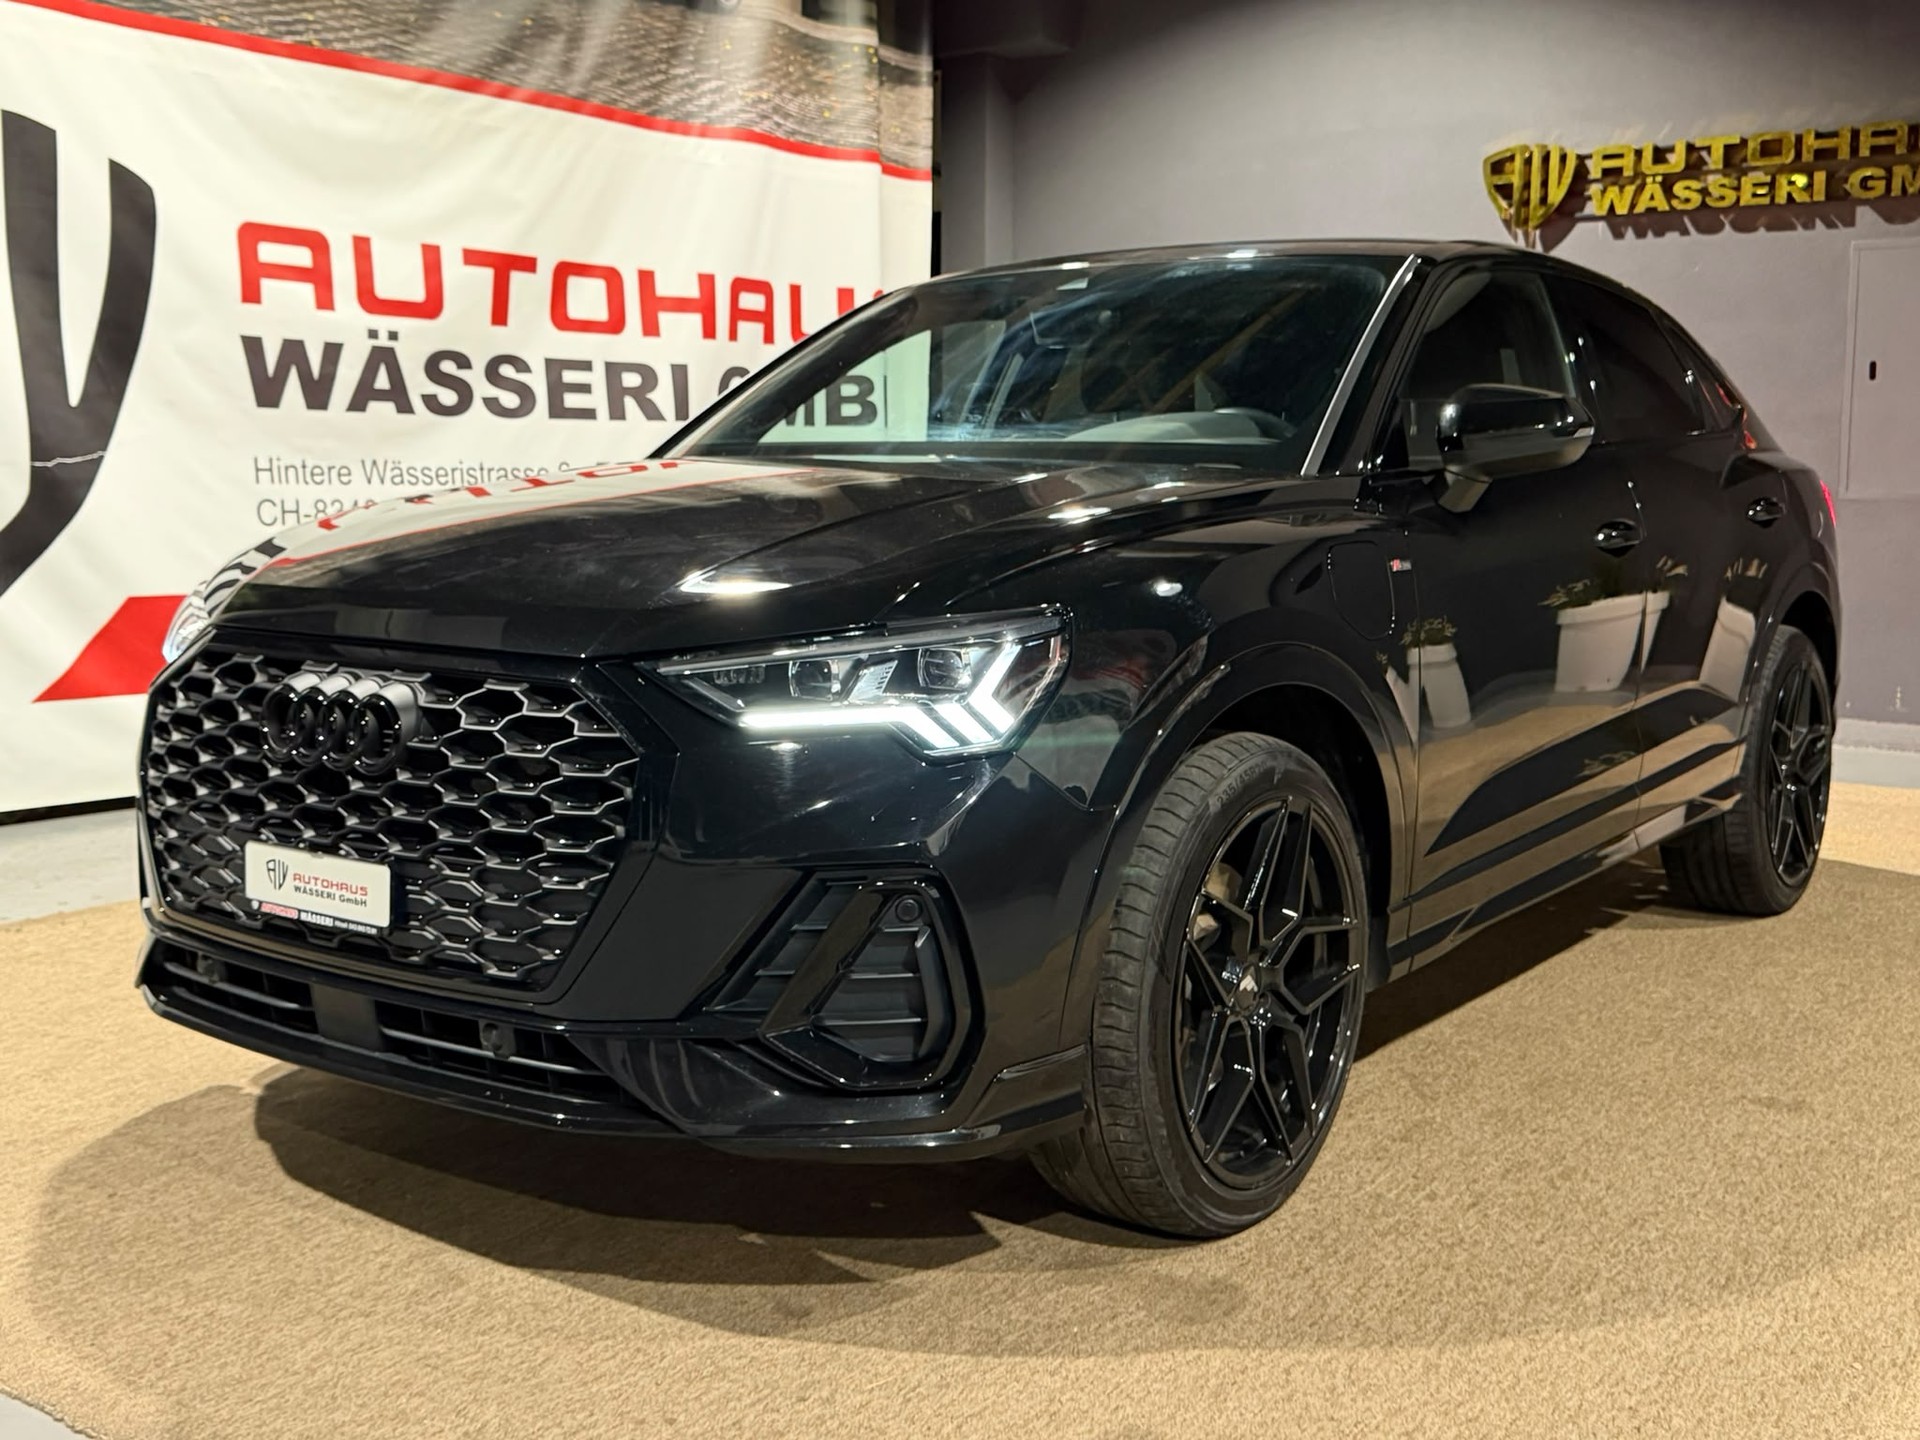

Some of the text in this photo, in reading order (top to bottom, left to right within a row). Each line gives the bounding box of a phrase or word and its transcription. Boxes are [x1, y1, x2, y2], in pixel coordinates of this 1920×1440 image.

[1591, 120, 1920, 177] AUTOHA
[1590, 170, 1827, 216] WÄSSERI
[236, 221, 884, 345] AUTOHAU
[239, 329, 690, 422] WÄSSERI
[253, 457, 352, 487] Hintere
[292, 872, 368, 896] AUTOHAUS
[338, 894, 368, 907] GmbH
